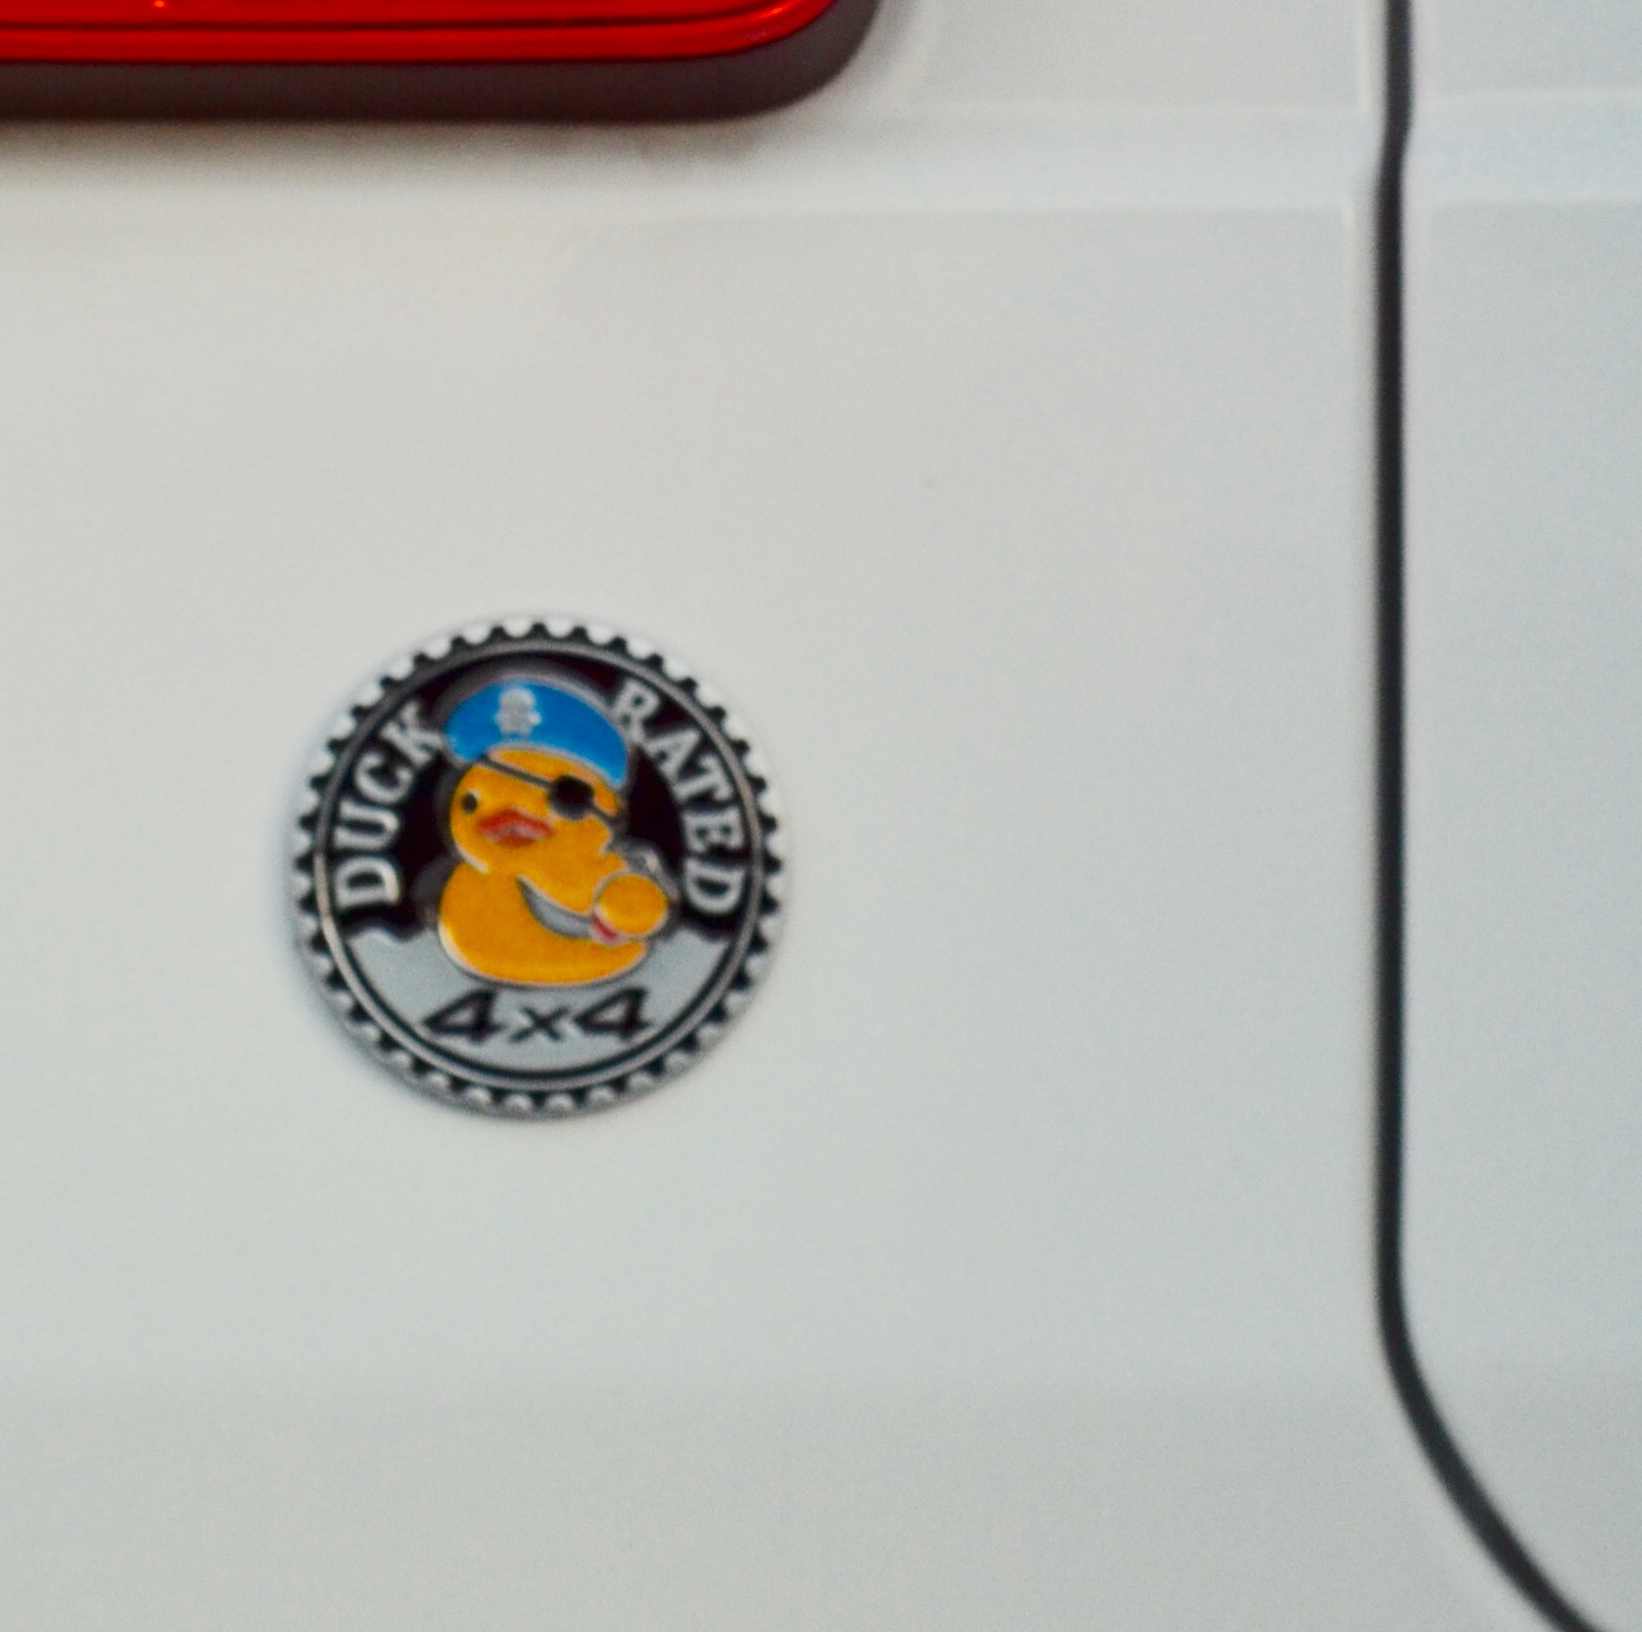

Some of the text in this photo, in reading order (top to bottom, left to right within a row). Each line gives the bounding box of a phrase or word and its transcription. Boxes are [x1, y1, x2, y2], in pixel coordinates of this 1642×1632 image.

[334, 678, 745, 916] DUCK RATED
[422, 986, 653, 1044] 4x4
